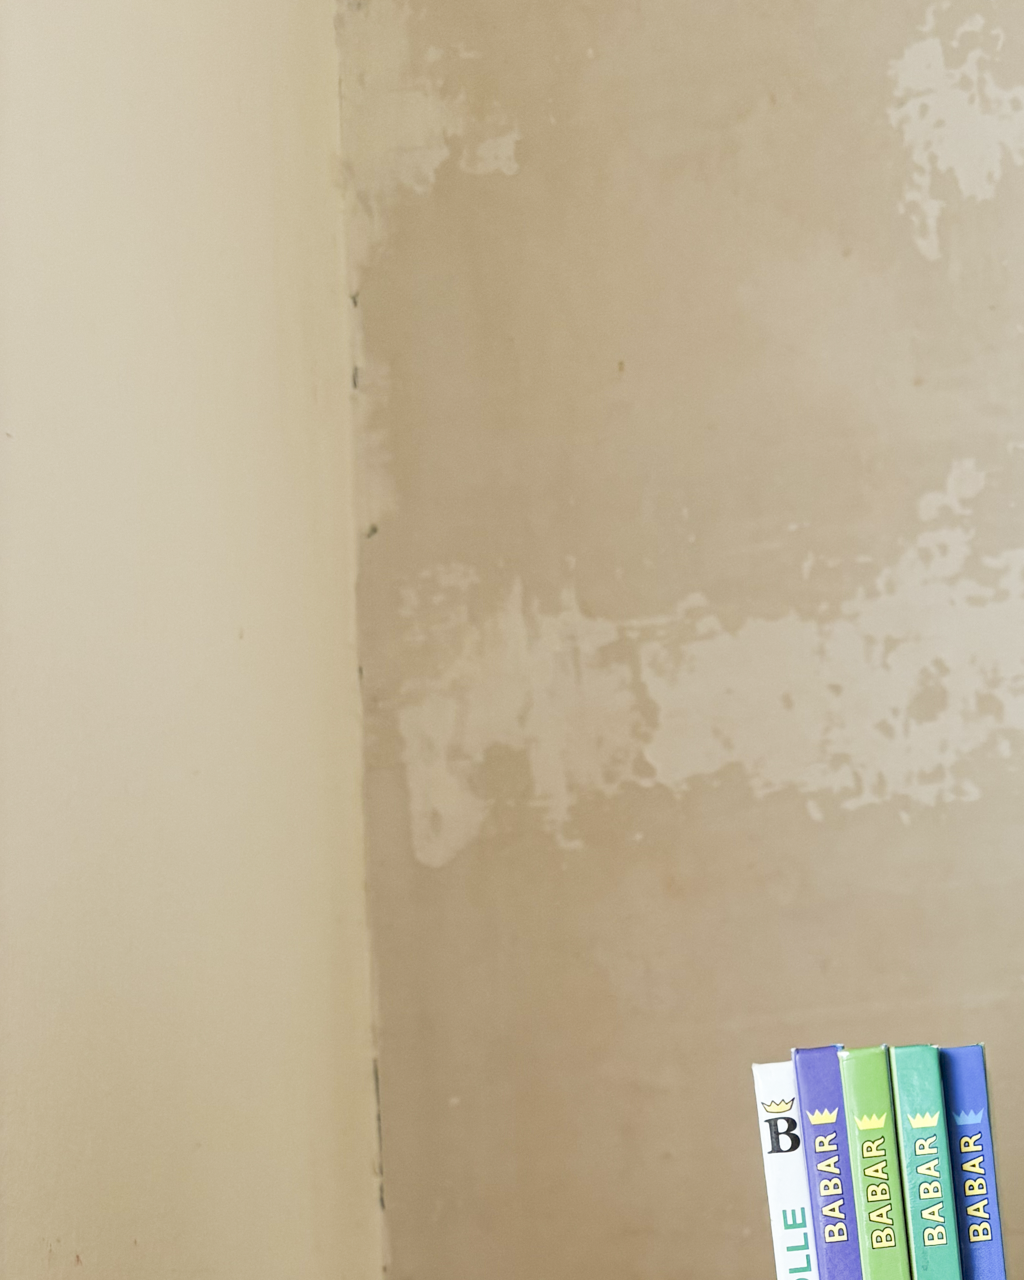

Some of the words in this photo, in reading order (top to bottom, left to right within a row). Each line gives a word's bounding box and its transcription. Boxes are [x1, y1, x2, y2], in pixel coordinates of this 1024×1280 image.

[765, 1117, 801, 1154] B
[814, 1131, 848, 1243] BABAR
[861, 1134, 896, 1249] BABAR
[914, 1133, 948, 1246] BABAR
[959, 1131, 993, 1243] BABAR
